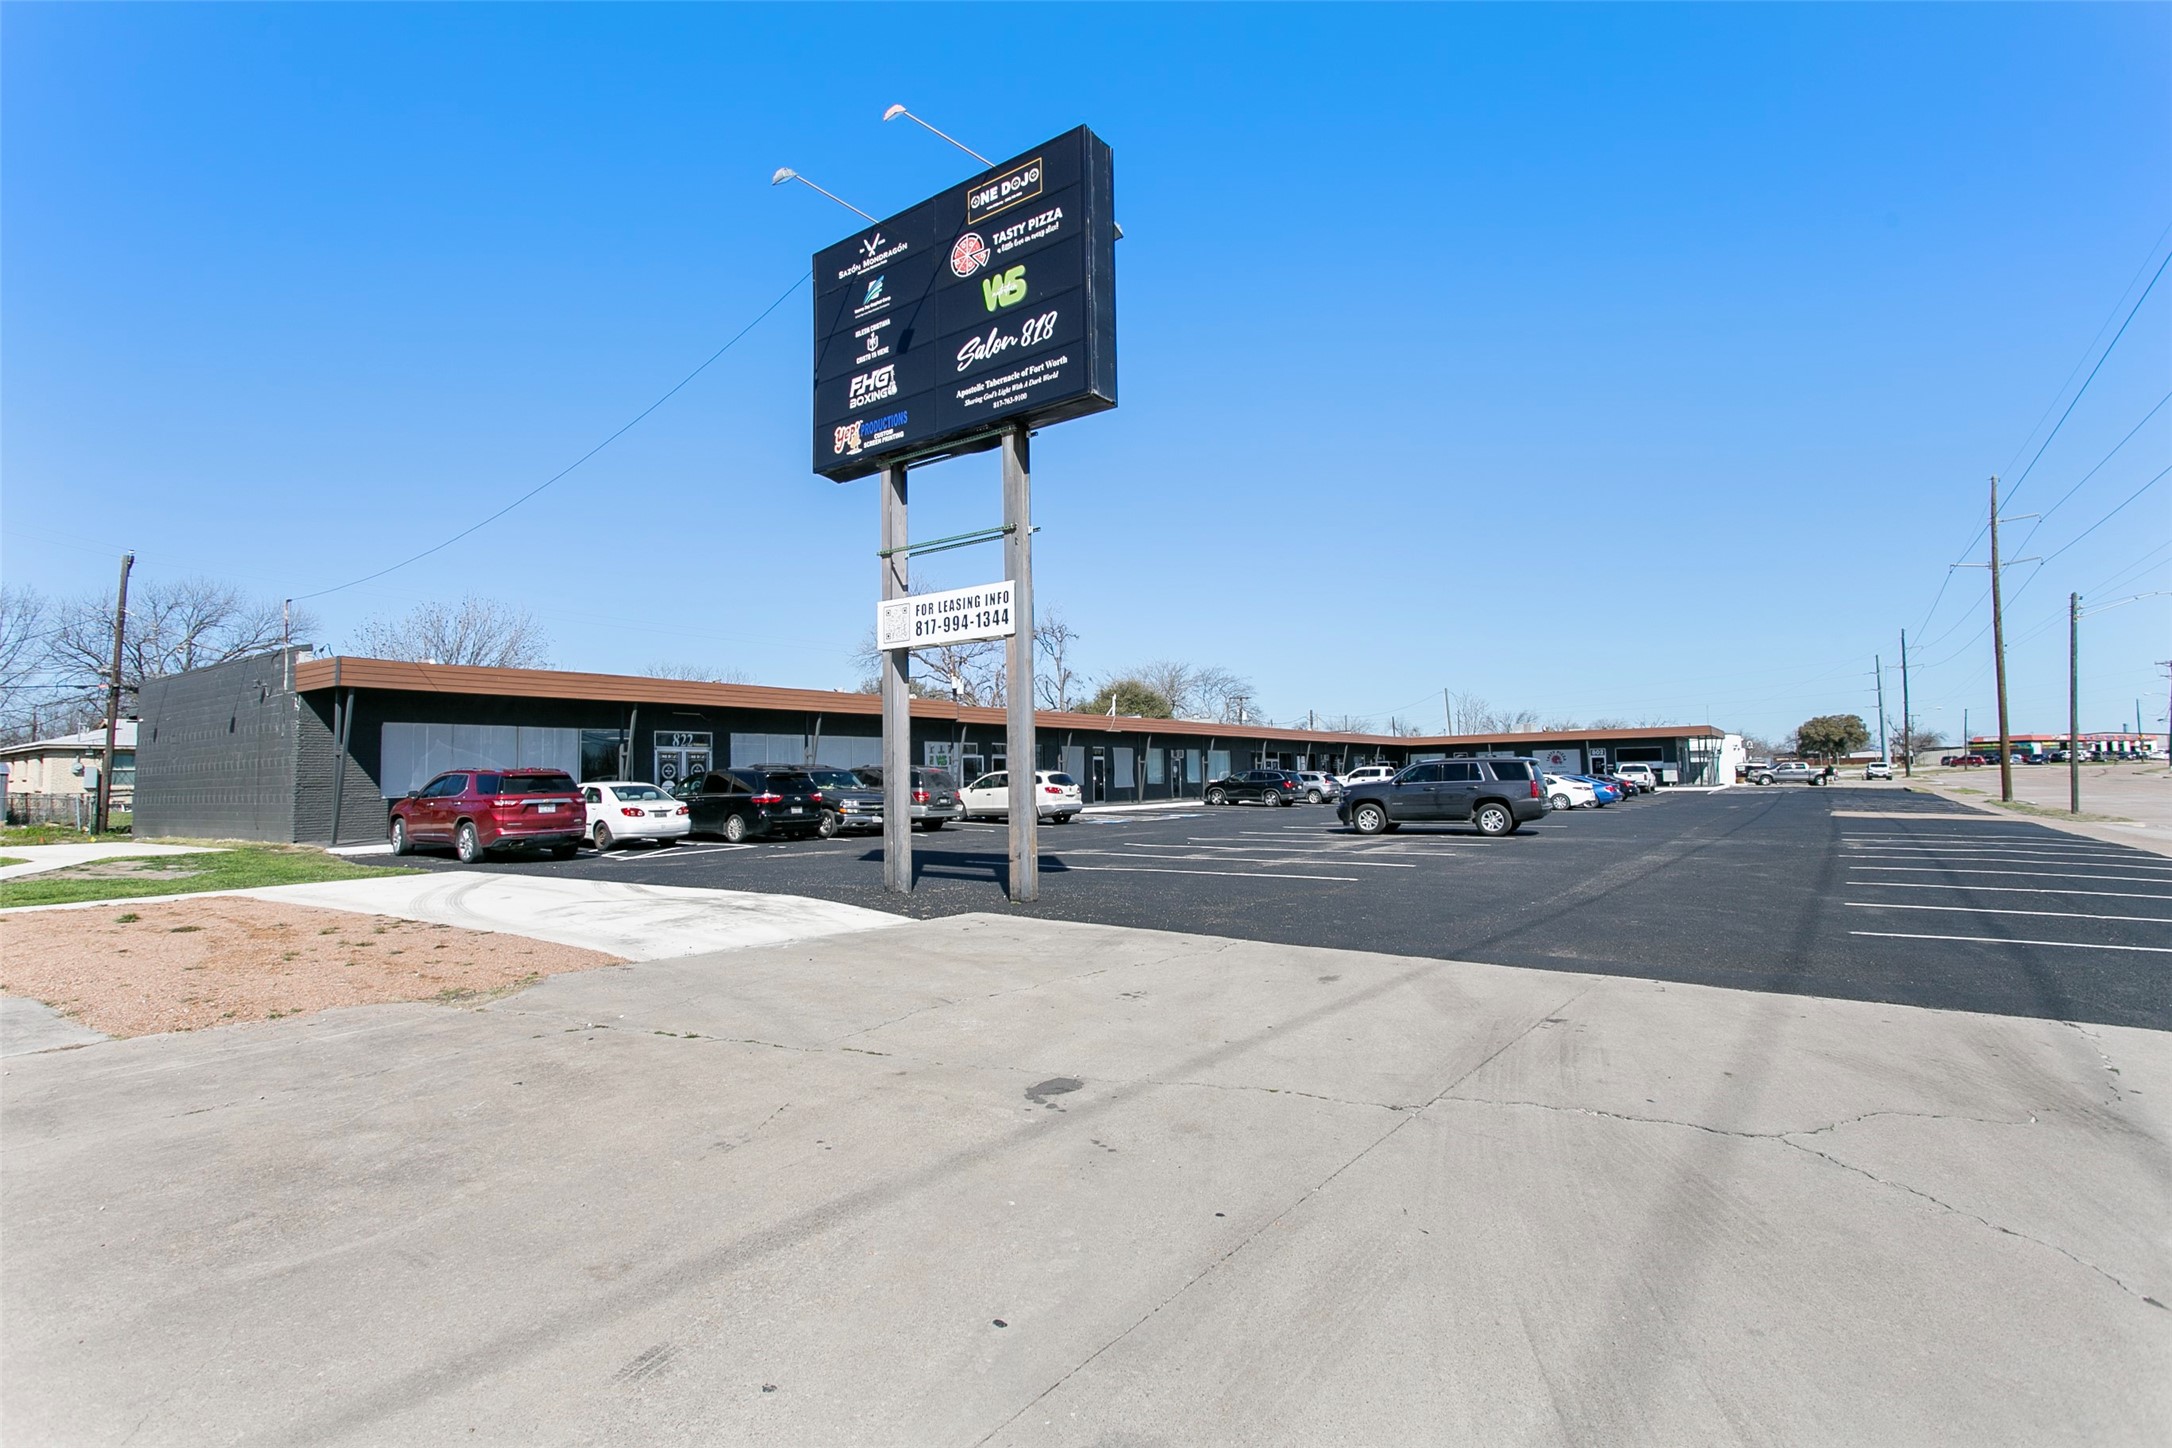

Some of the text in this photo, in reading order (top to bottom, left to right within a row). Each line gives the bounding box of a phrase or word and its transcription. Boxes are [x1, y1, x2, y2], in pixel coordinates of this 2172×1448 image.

[971, 186, 998, 208] ONE
[1001, 168, 1039, 196] DOJO
[992, 207, 1063, 245] TASTY PIZZA
[957, 310, 1057, 372] Salon 818
[849, 364, 895, 398] FHG
[956, 355, 1068, 399] Apostolic Tabernacle of Fort Worth
[964, 396, 984, 407] Sharing
[997, 386, 1012, 397] Light
[1012, 382, 1023, 392] With
[1023, 380, 1029, 388] A
[1029, 376, 1042, 387] Dark
[1042, 370, 1059, 382] World
[849, 387, 889, 410] BOXING
[861, 410, 908, 437] PRODUCTIONS
[863, 430, 905, 449] SCREEN PRINTING
[915, 590, 1009, 617] FOR LEASING INFO
[915, 608, 1009, 637] 817-994-1344
[672, 733, 693, 747] 822
